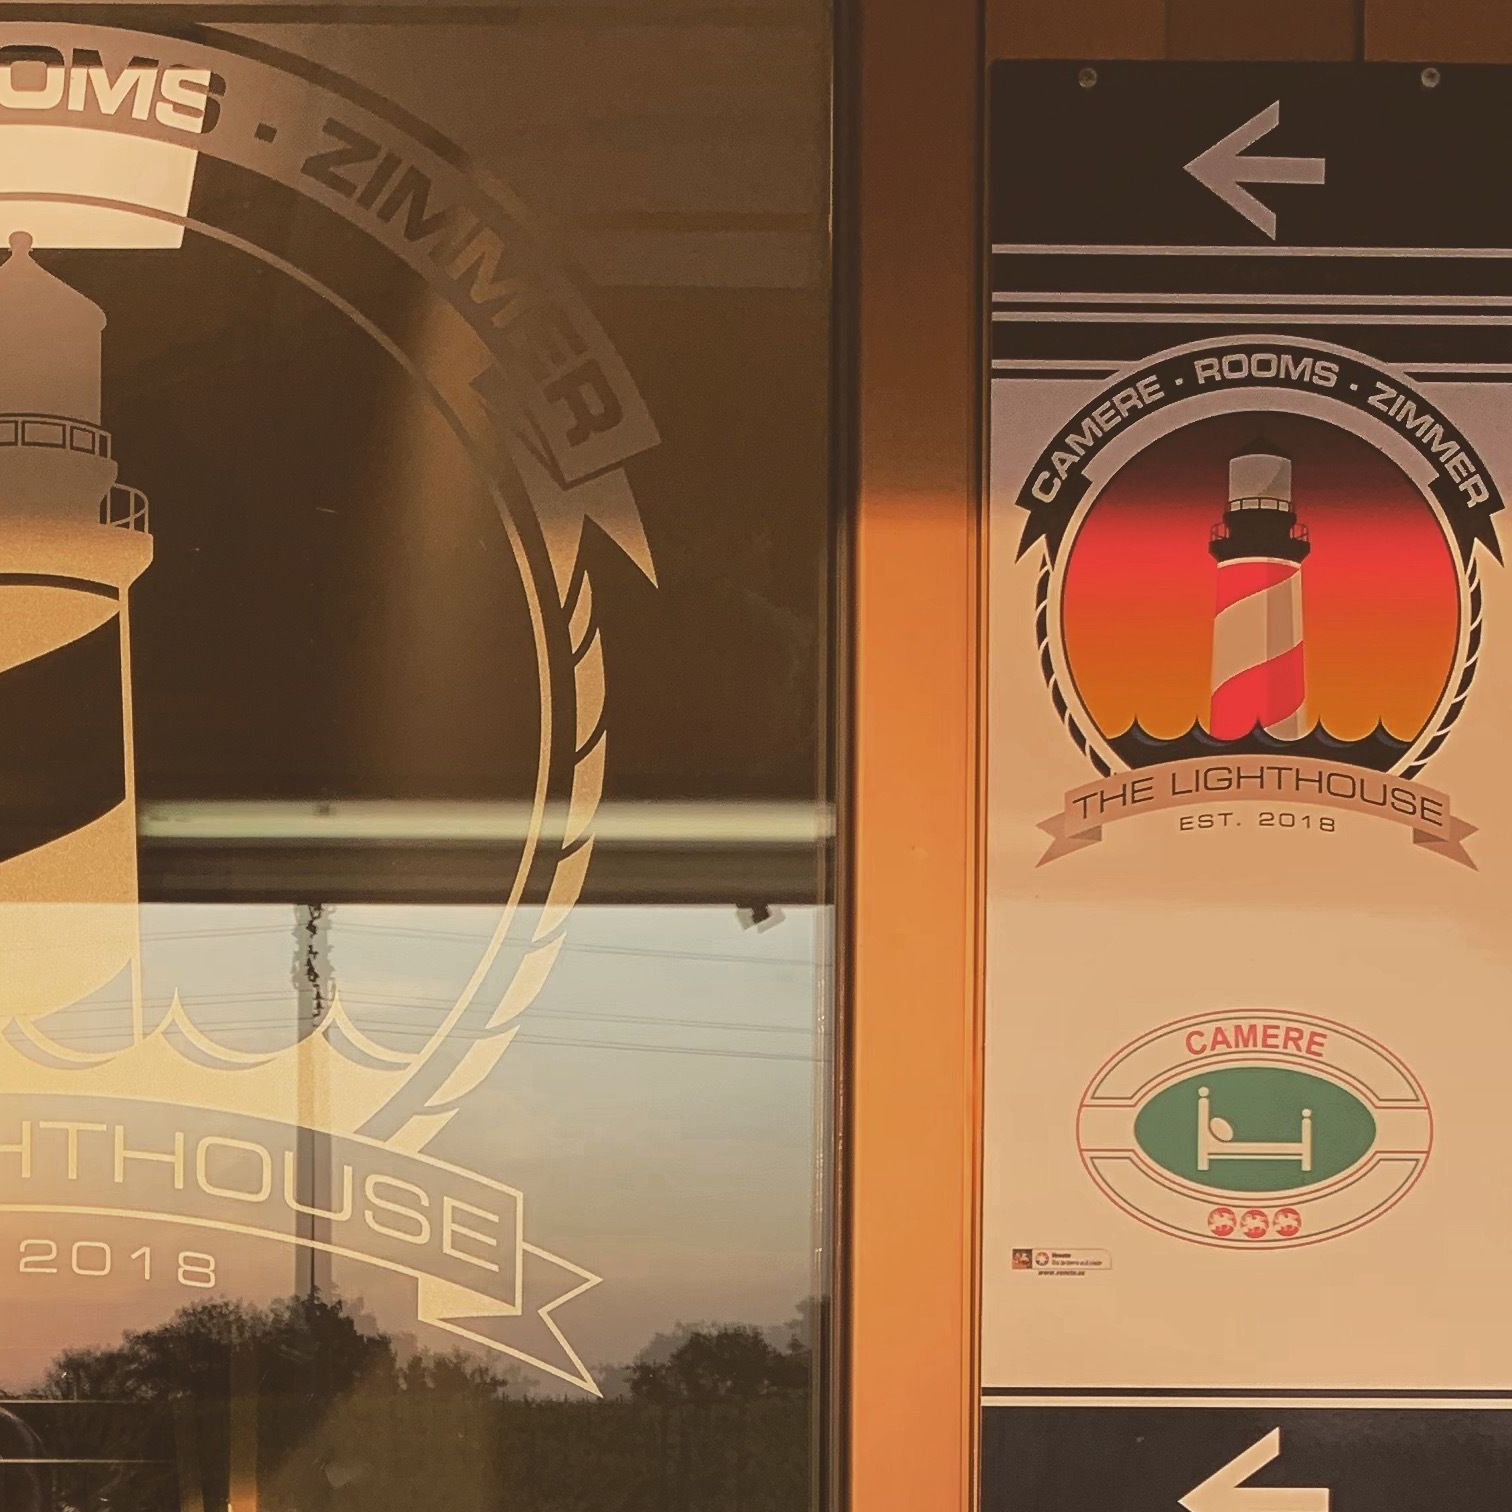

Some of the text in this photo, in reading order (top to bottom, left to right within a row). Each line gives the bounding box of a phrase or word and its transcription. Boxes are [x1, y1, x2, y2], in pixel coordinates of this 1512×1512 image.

[300, 117, 625, 448] ZIMMER
[1031, 353, 1490, 509] CAMERE ROOMS ZIMMER
[1072, 765, 1445, 828] THE LIGHTHOUSE
[1179, 811, 1336, 832] EST. 2018
[1184, 1023, 1328, 1058] CAMERE
[18, 1238, 217, 1289] 2018
